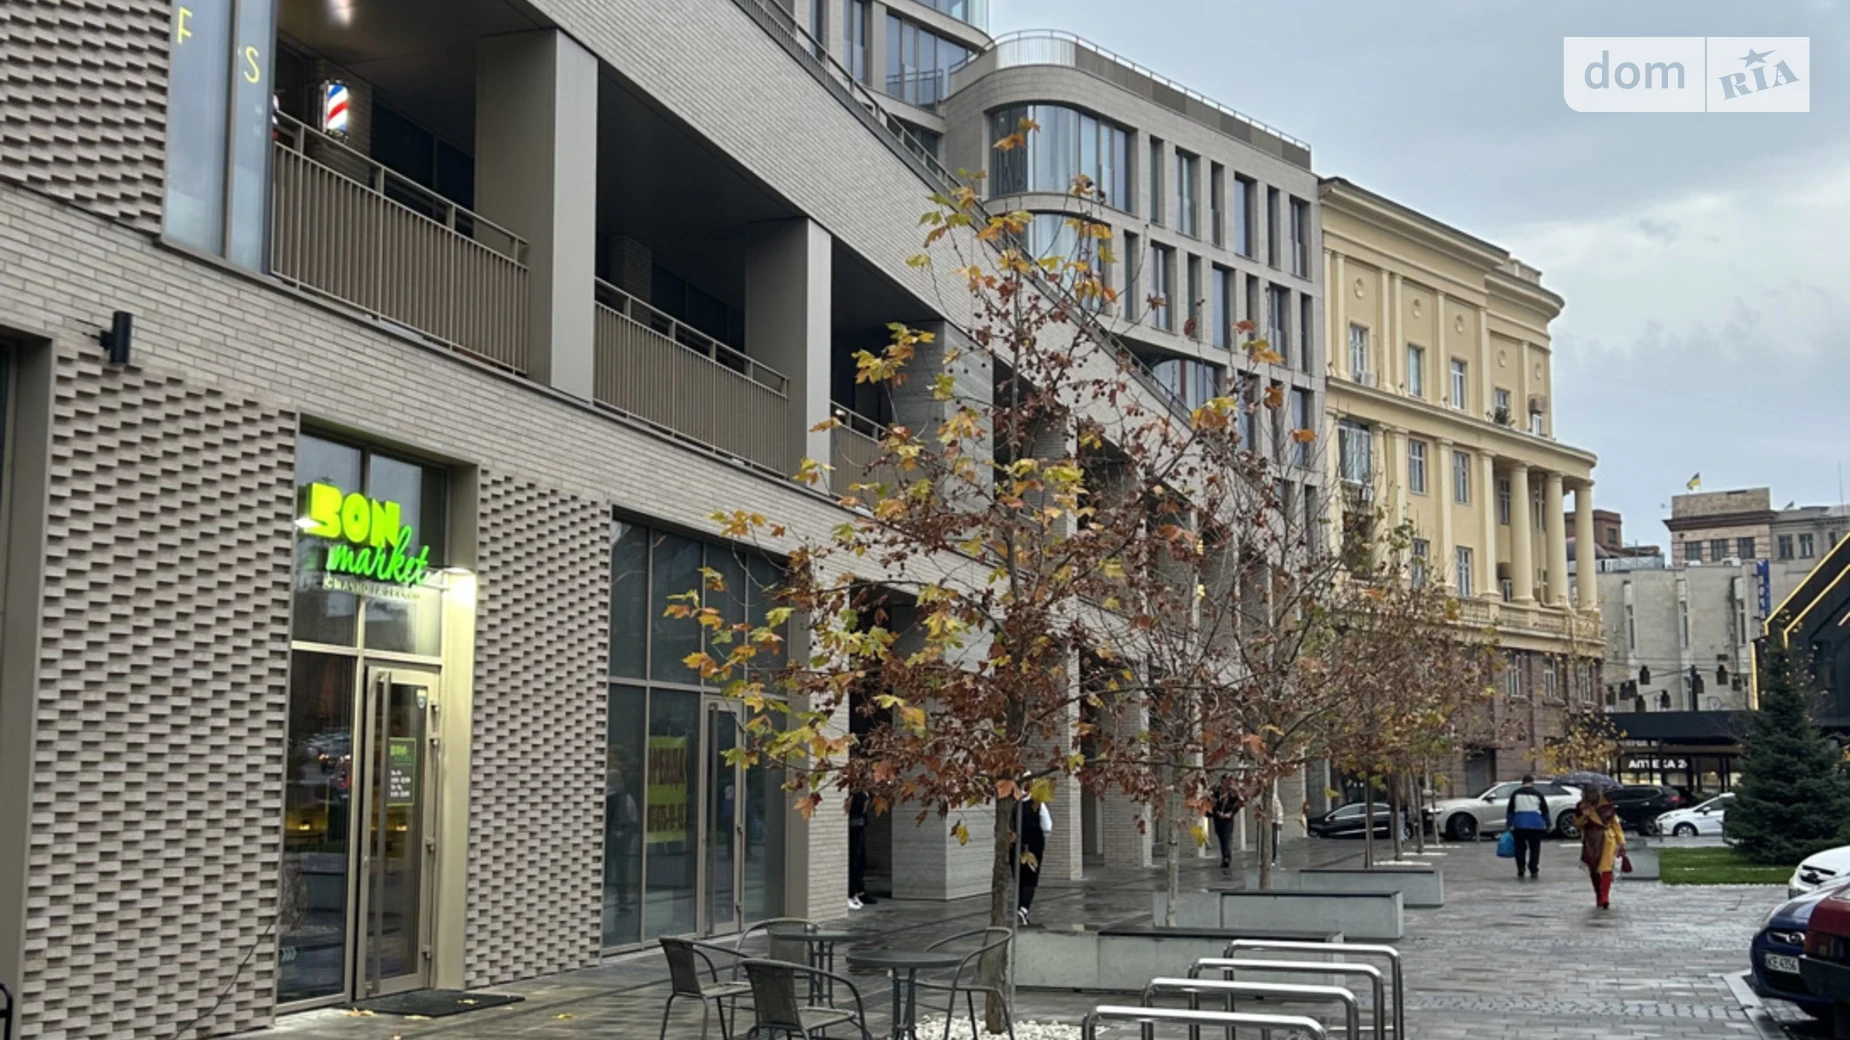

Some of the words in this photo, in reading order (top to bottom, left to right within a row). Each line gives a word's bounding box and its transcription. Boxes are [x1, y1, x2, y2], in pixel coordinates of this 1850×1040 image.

[177, 6, 193, 45] F
[243, 46, 260, 84] S
[303, 482, 400, 547] BON
[326, 525, 431, 585] market
